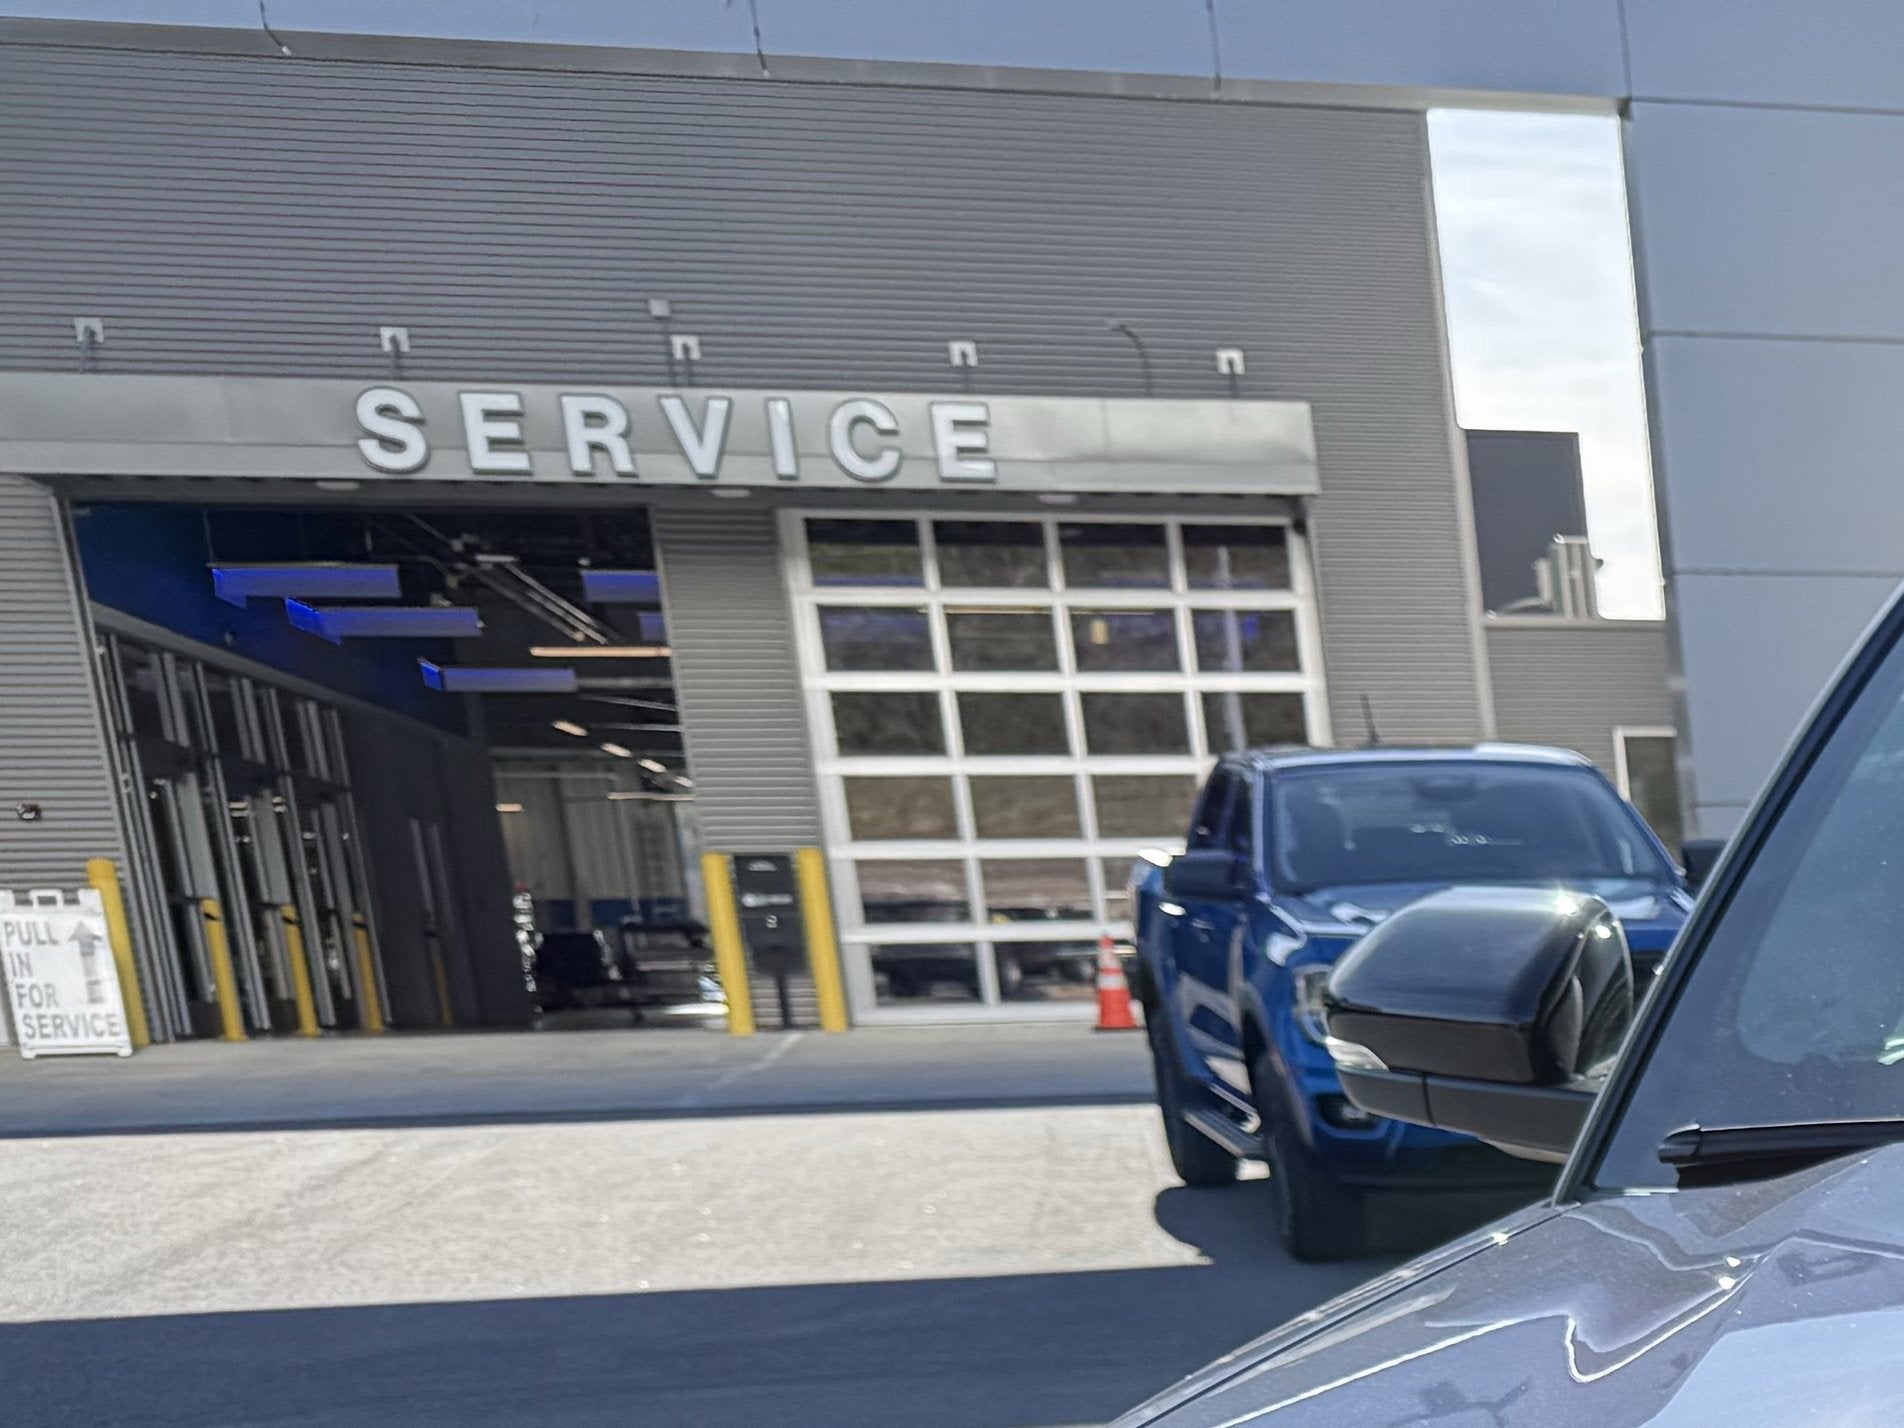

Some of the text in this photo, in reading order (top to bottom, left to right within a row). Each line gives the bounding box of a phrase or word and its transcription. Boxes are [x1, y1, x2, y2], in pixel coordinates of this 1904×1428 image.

[355, 387, 998, 482] SERVICE
[5, 921, 60, 945] PULL
[9, 953, 33, 978] IN
[15, 983, 60, 1010] FOR
[23, 1013, 120, 1039] SERVICE
